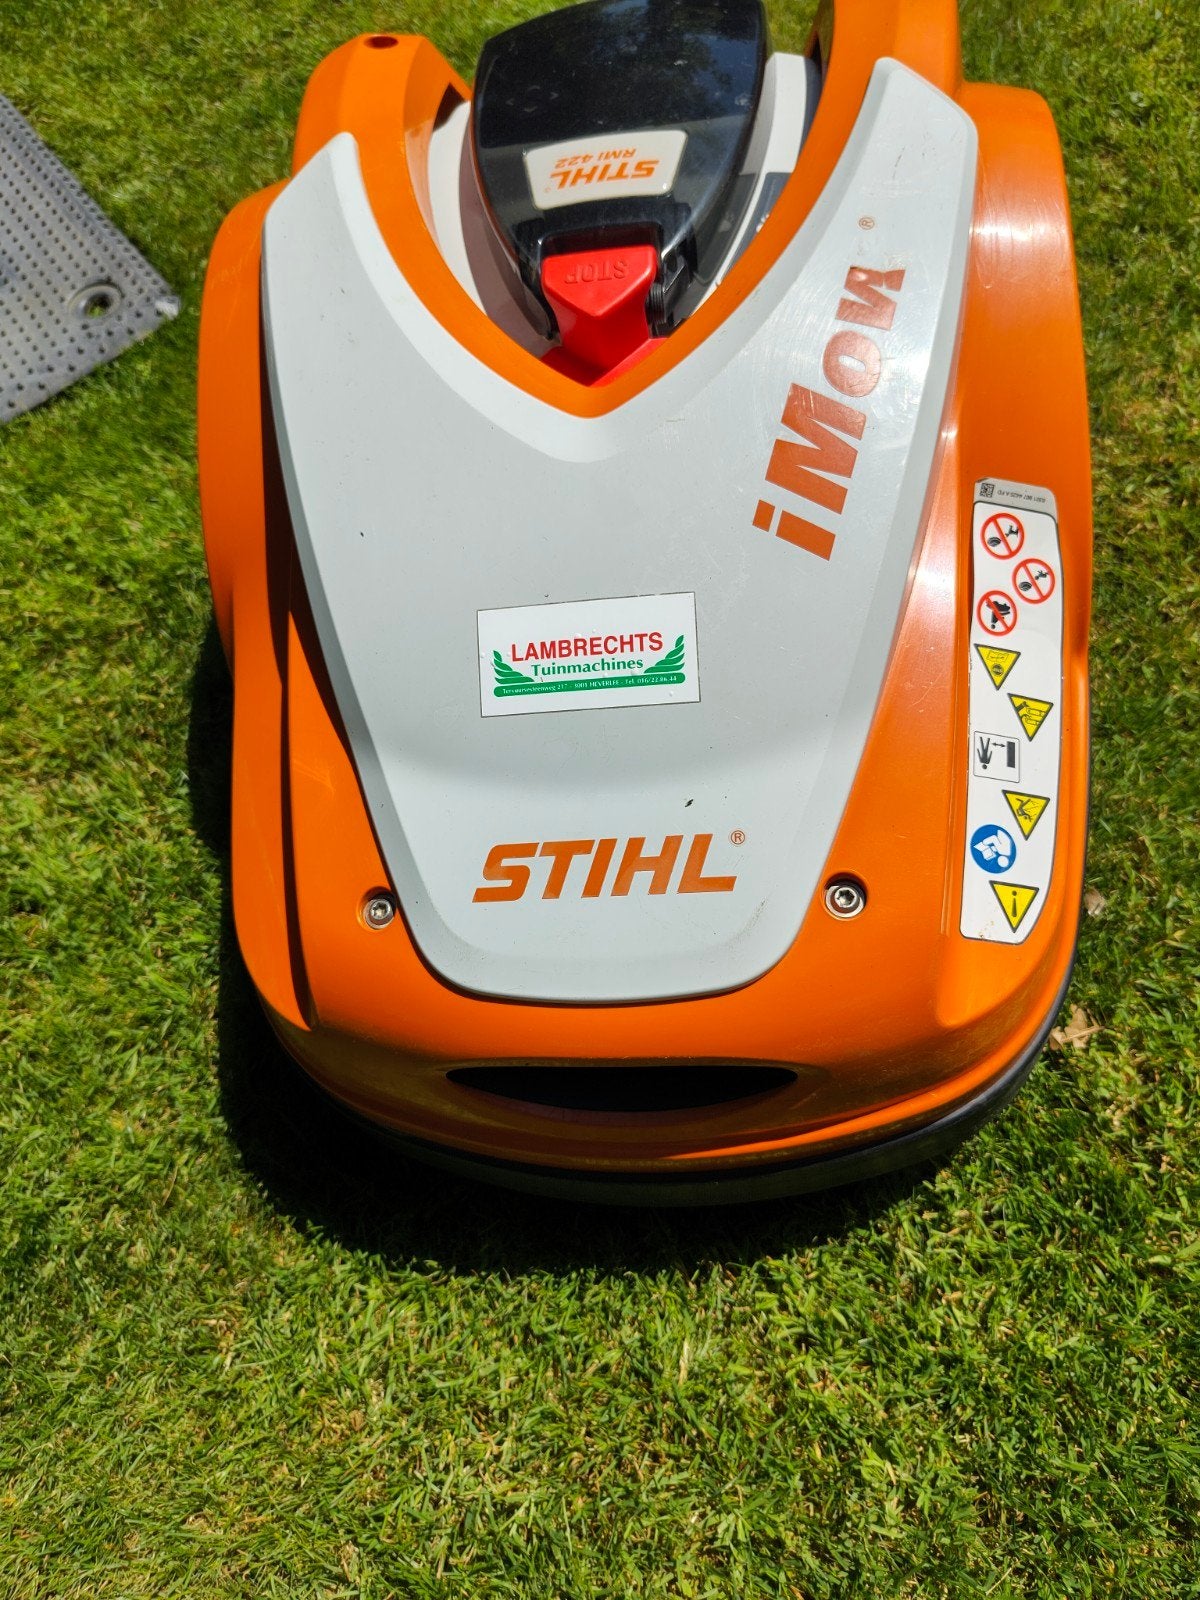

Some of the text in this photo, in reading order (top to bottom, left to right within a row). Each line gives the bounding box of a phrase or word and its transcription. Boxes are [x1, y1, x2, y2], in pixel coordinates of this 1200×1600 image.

[555, 148, 636, 168] RMI 422
[550, 160, 659, 189] STIHL
[564, 261, 627, 284] STOP
[511, 632, 663, 662] LAMBRECHTS
[531, 658, 643, 677] Tuinmachines
[472, 833, 737, 903] STIHL
